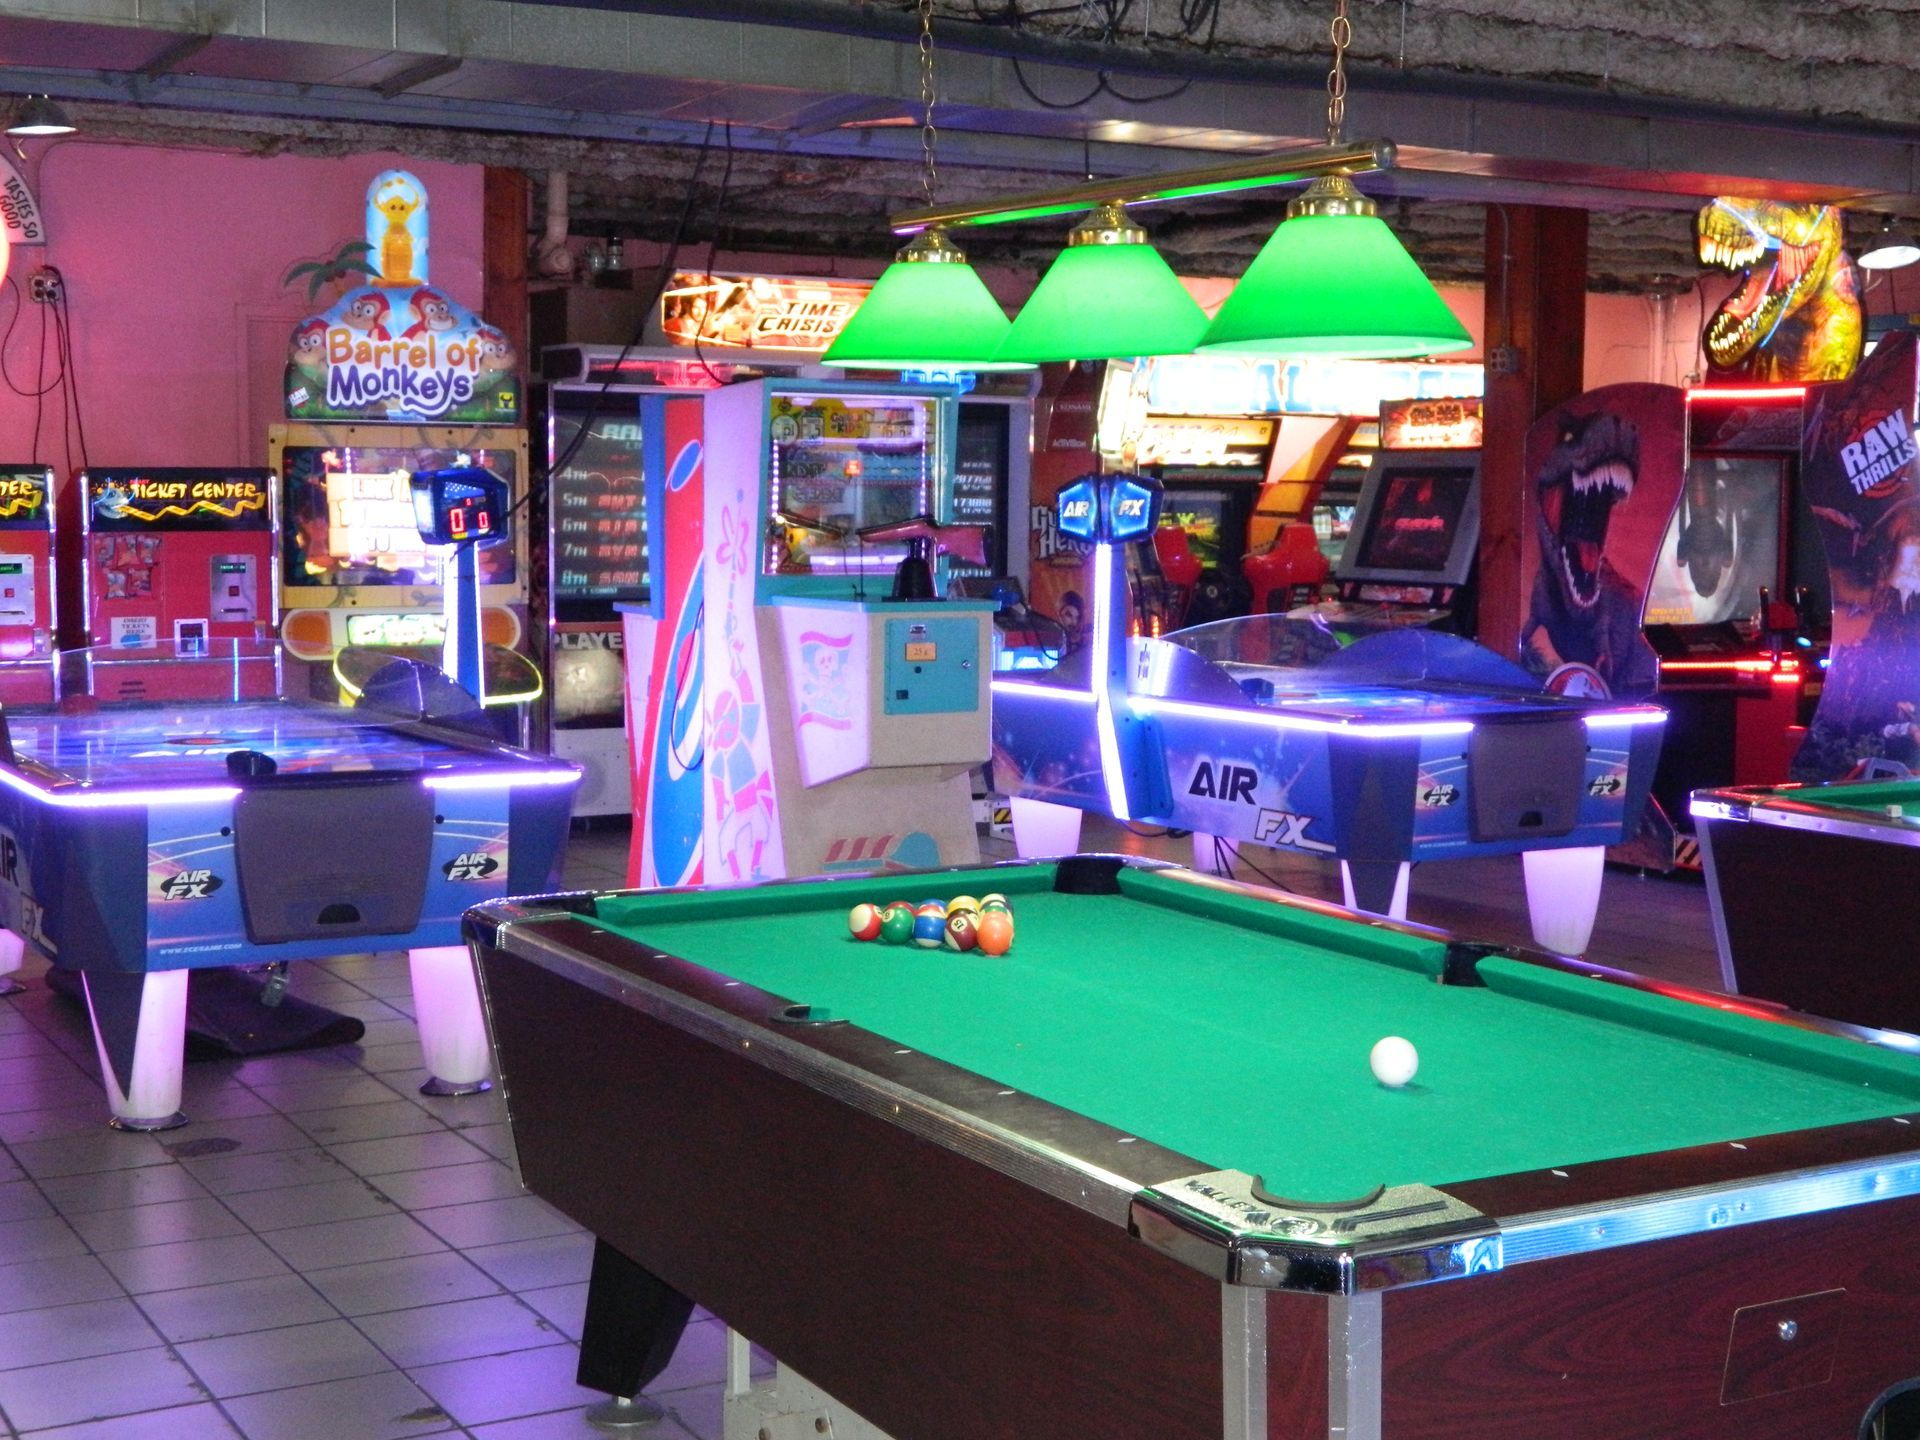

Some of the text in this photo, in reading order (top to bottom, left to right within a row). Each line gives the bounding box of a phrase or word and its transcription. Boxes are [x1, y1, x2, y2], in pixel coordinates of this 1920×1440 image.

[0, 195, 21, 229] GOOD
[4, 176, 38, 238] TASTES SO
[785, 302, 846, 316] TIME
[757, 316, 837, 332] CRISIS
[329, 328, 481, 372] Barrel of
[330, 364, 471, 410] Monkeys
[1840, 408, 1909, 477] RAW
[1851, 439, 1917, 495] THRILLS
[130, 482, 257, 499] TICKET CENTER
[1063, 500, 1090, 518] AIR
[1118, 499, 1145, 516] FX
[450, 508, 464, 532] 0
[478, 511, 489, 529] 0
[1189, 761, 1258, 806] AIR
[1594, 774, 1616, 785] AIR
[1431, 784, 1454, 795] AIR
[1589, 784, 1613, 796] FX
[1426, 795, 1451, 806] FX
[1254, 807, 1337, 853] FX
[0, 833, 19, 887] IR
[453, 852, 488, 866] AIR
[174, 869, 212, 883] AIR
[447, 865, 486, 881] FX
[165, 883, 209, 900] FX
